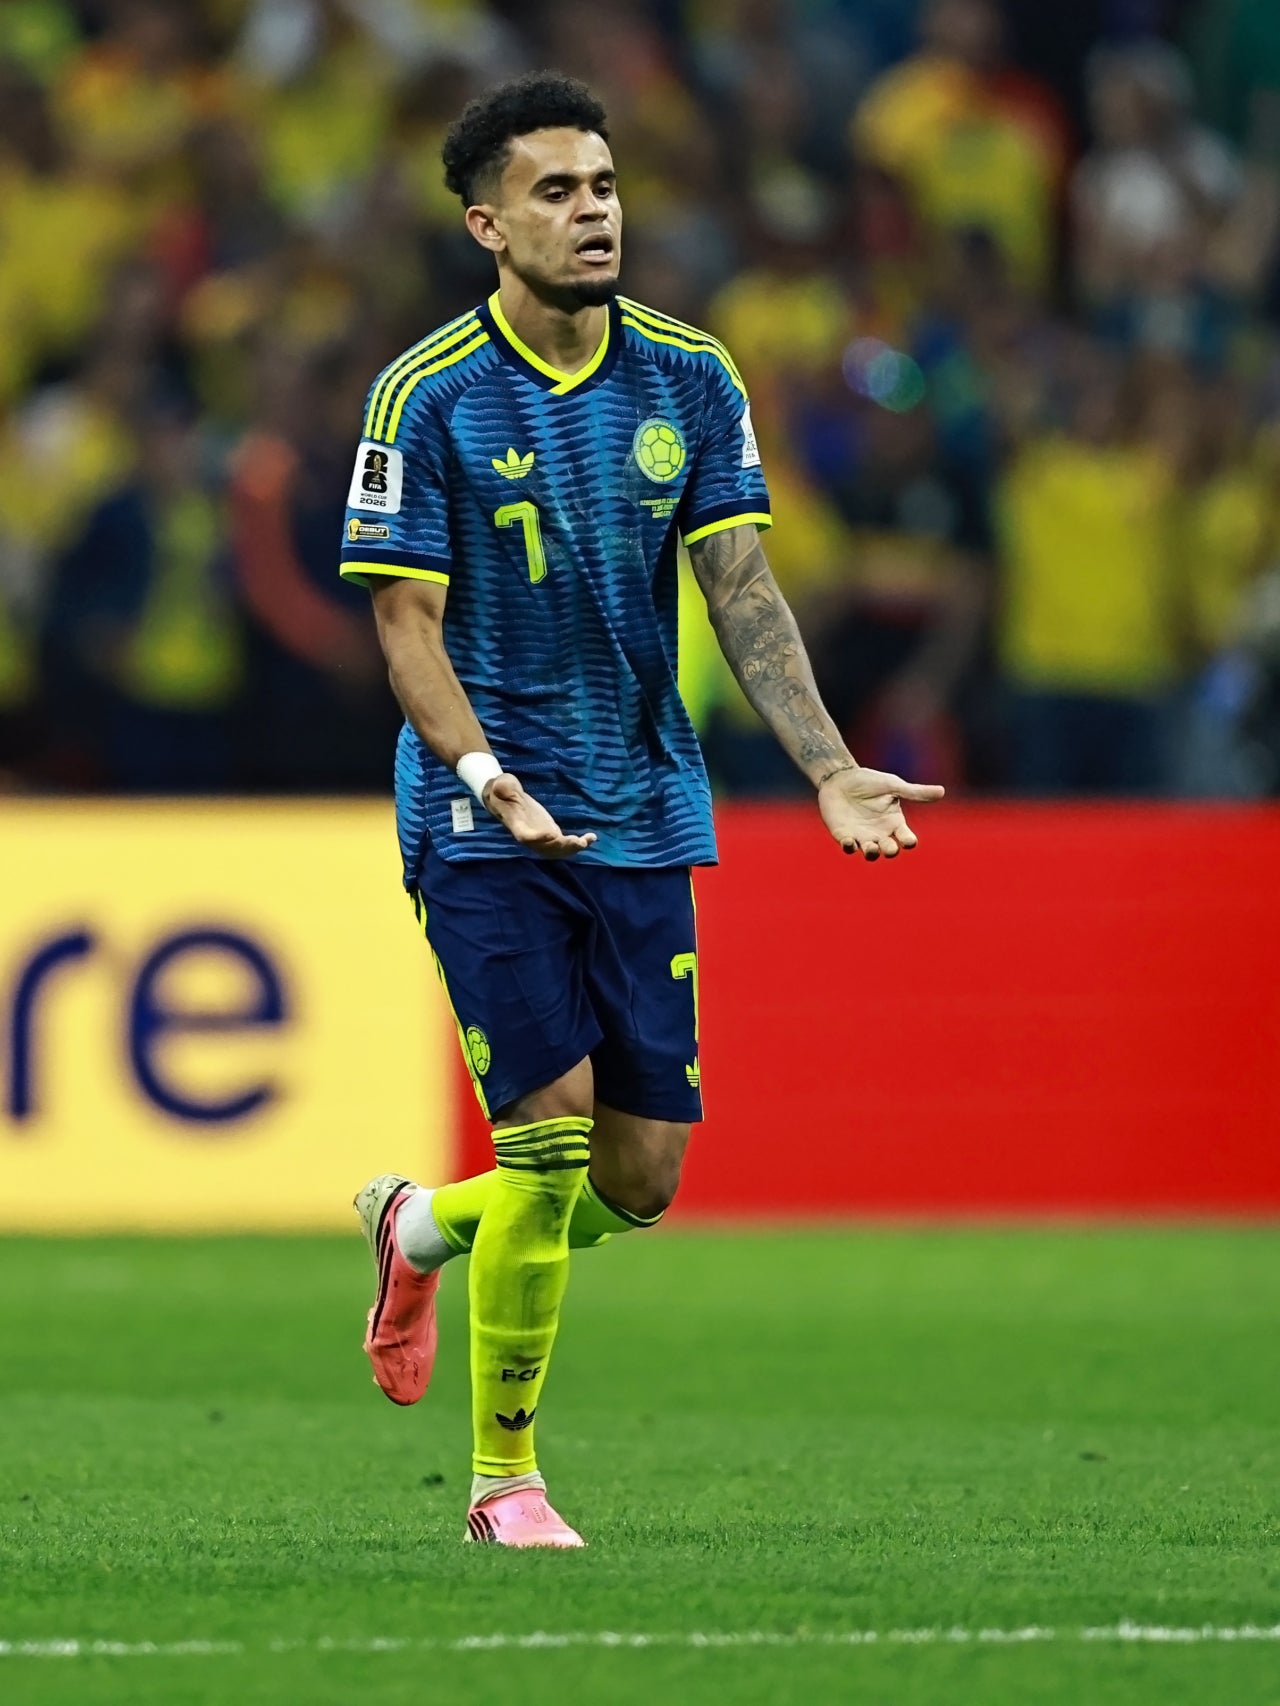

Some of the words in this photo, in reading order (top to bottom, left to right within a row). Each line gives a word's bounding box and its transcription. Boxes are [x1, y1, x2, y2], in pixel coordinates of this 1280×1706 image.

[360, 497, 387, 507] 2026
[494, 501, 548, 583] 7
[502, 1367, 541, 1382] FCF
